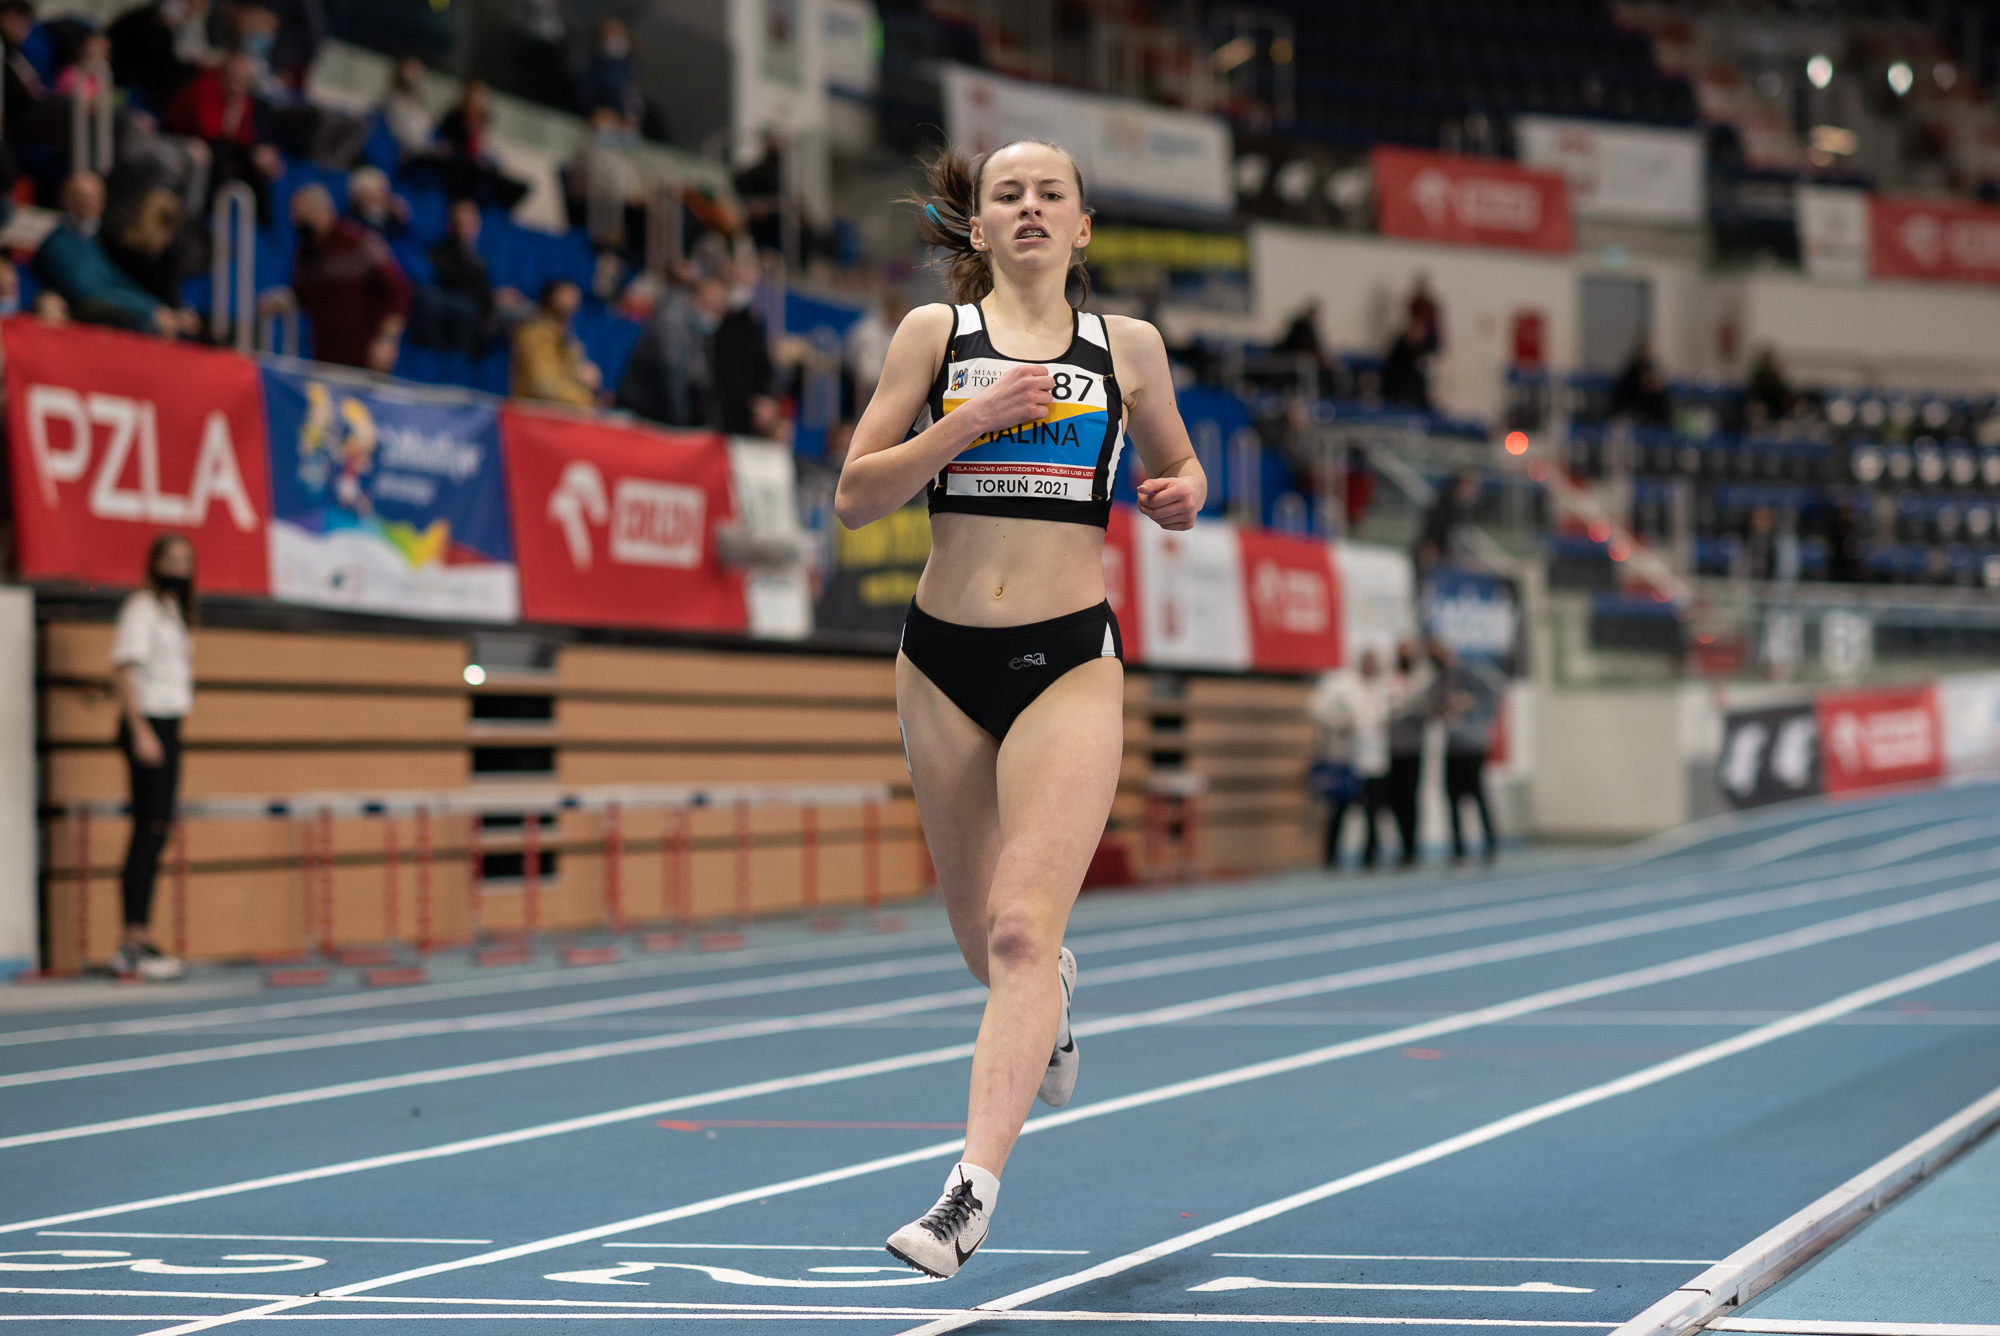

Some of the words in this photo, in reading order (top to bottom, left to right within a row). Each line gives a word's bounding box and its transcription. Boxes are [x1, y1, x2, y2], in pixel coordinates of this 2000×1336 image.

[1051, 372, 1094, 402] 87
[26, 383, 259, 532] PZLA
[976, 476, 1029, 493] TORUŃ
[1034, 480, 1068, 496] 2021
